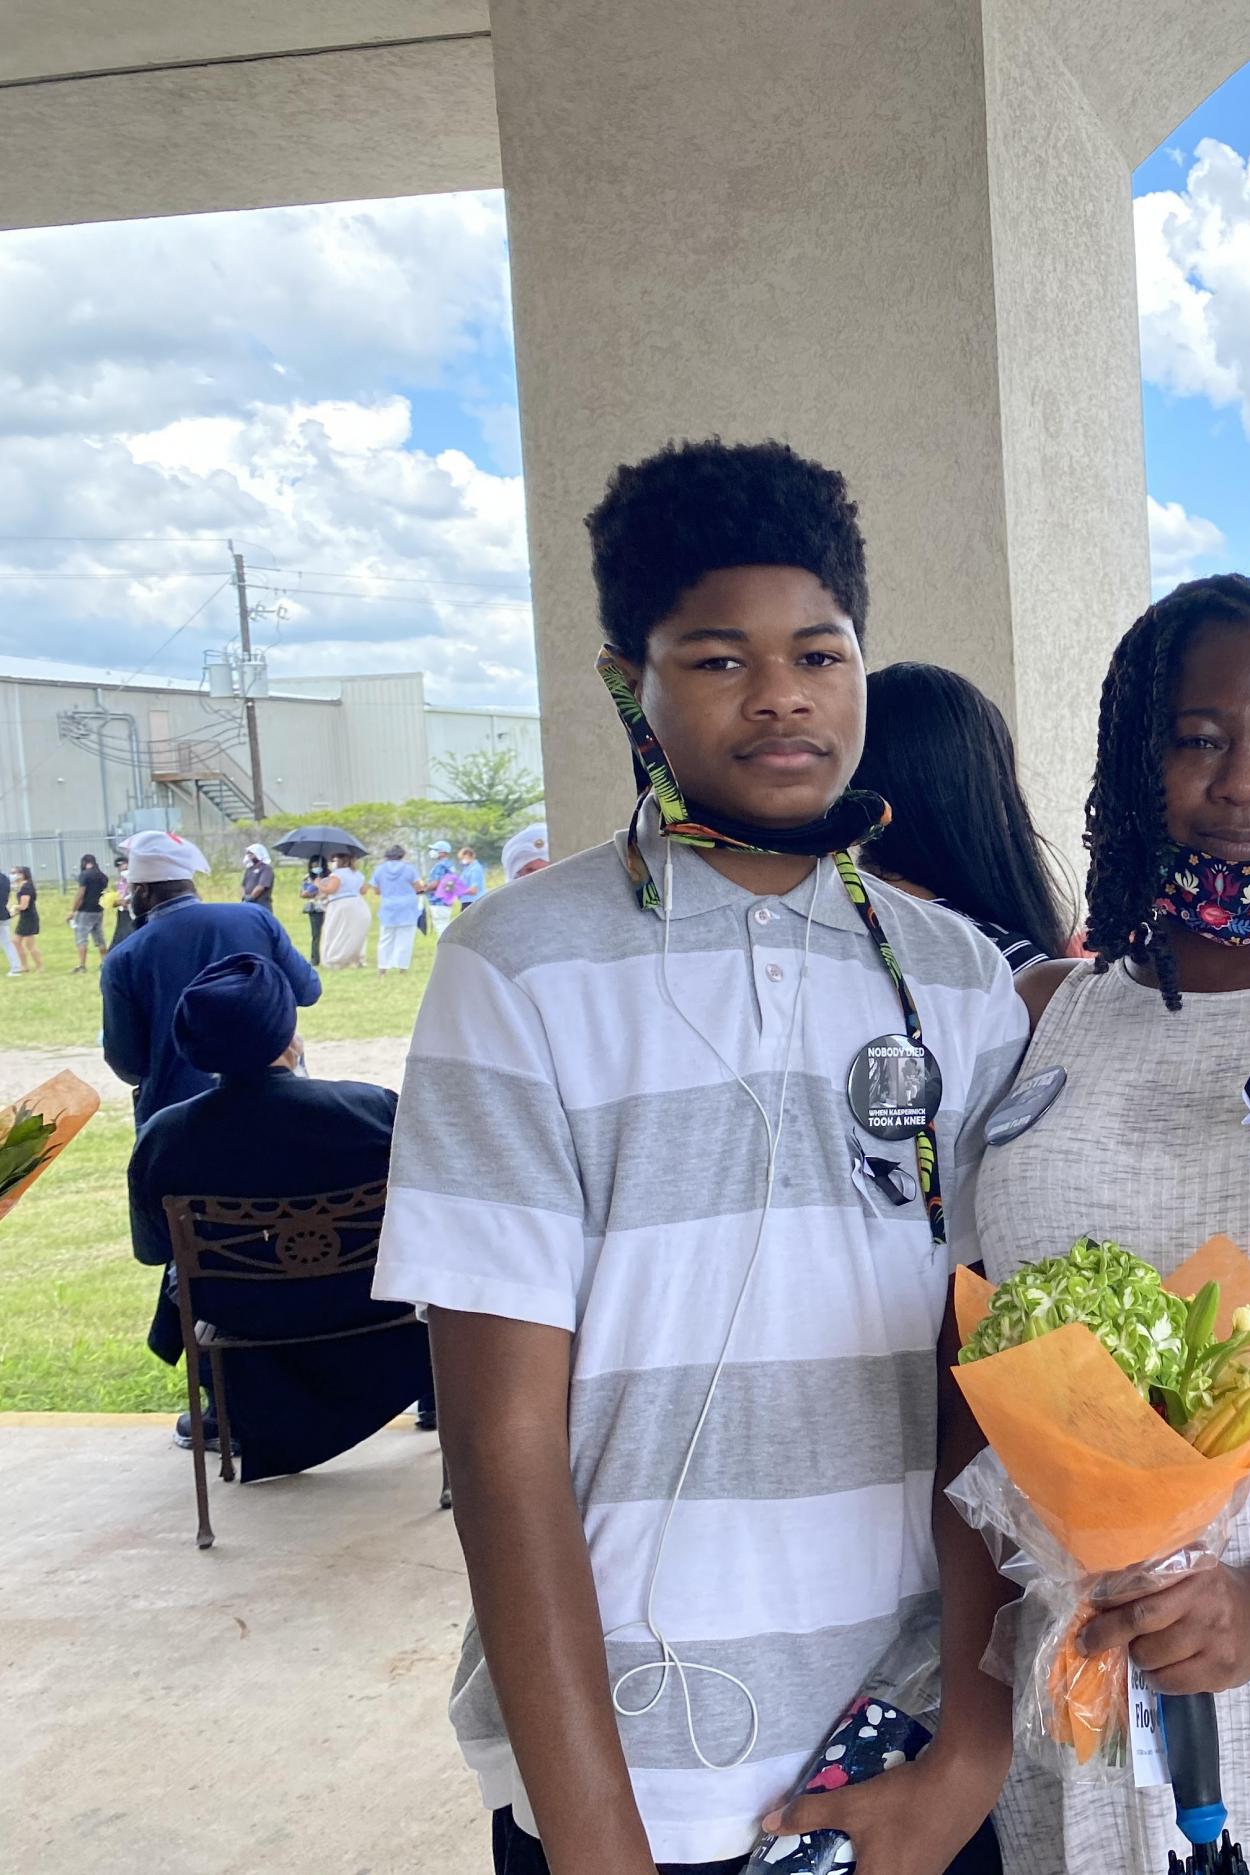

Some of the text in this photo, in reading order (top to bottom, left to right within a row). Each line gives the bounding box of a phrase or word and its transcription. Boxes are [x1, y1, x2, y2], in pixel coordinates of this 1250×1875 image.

[868, 1047, 925, 1058] NOBODY DIED
[868, 1109, 888, 1117] WHEN
[868, 1115, 926, 1127] TOOK A KNEE
